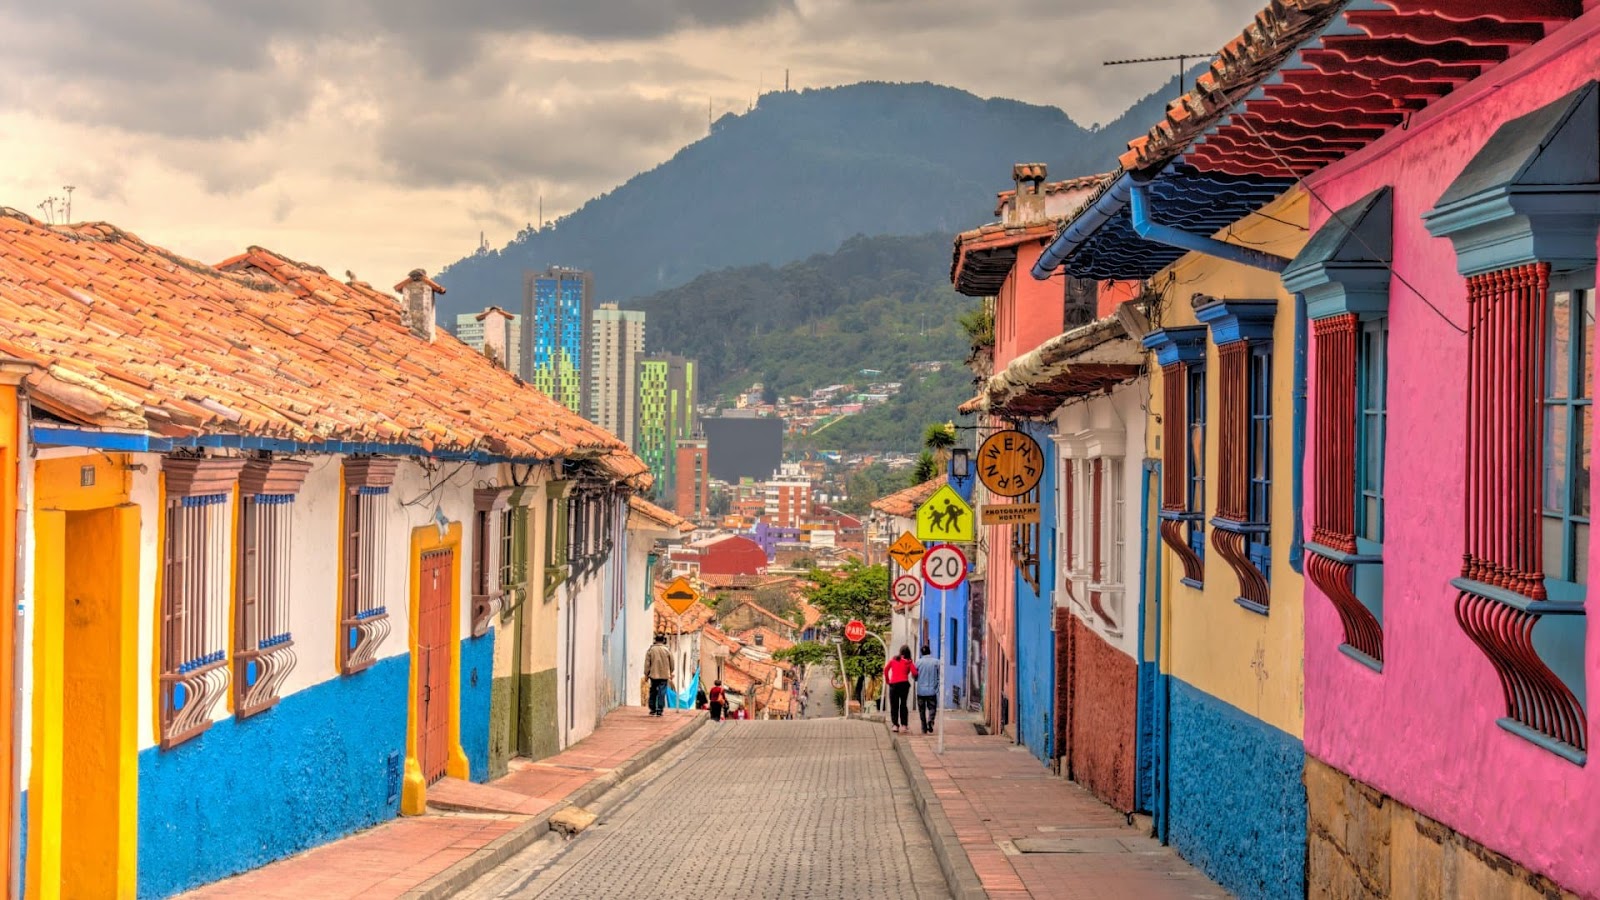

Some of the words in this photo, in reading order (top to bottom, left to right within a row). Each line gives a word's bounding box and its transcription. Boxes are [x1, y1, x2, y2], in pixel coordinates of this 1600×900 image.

[930, 556, 959, 578] 20
[897, 583, 916, 596] 20
[847, 626, 864, 636] PARE
